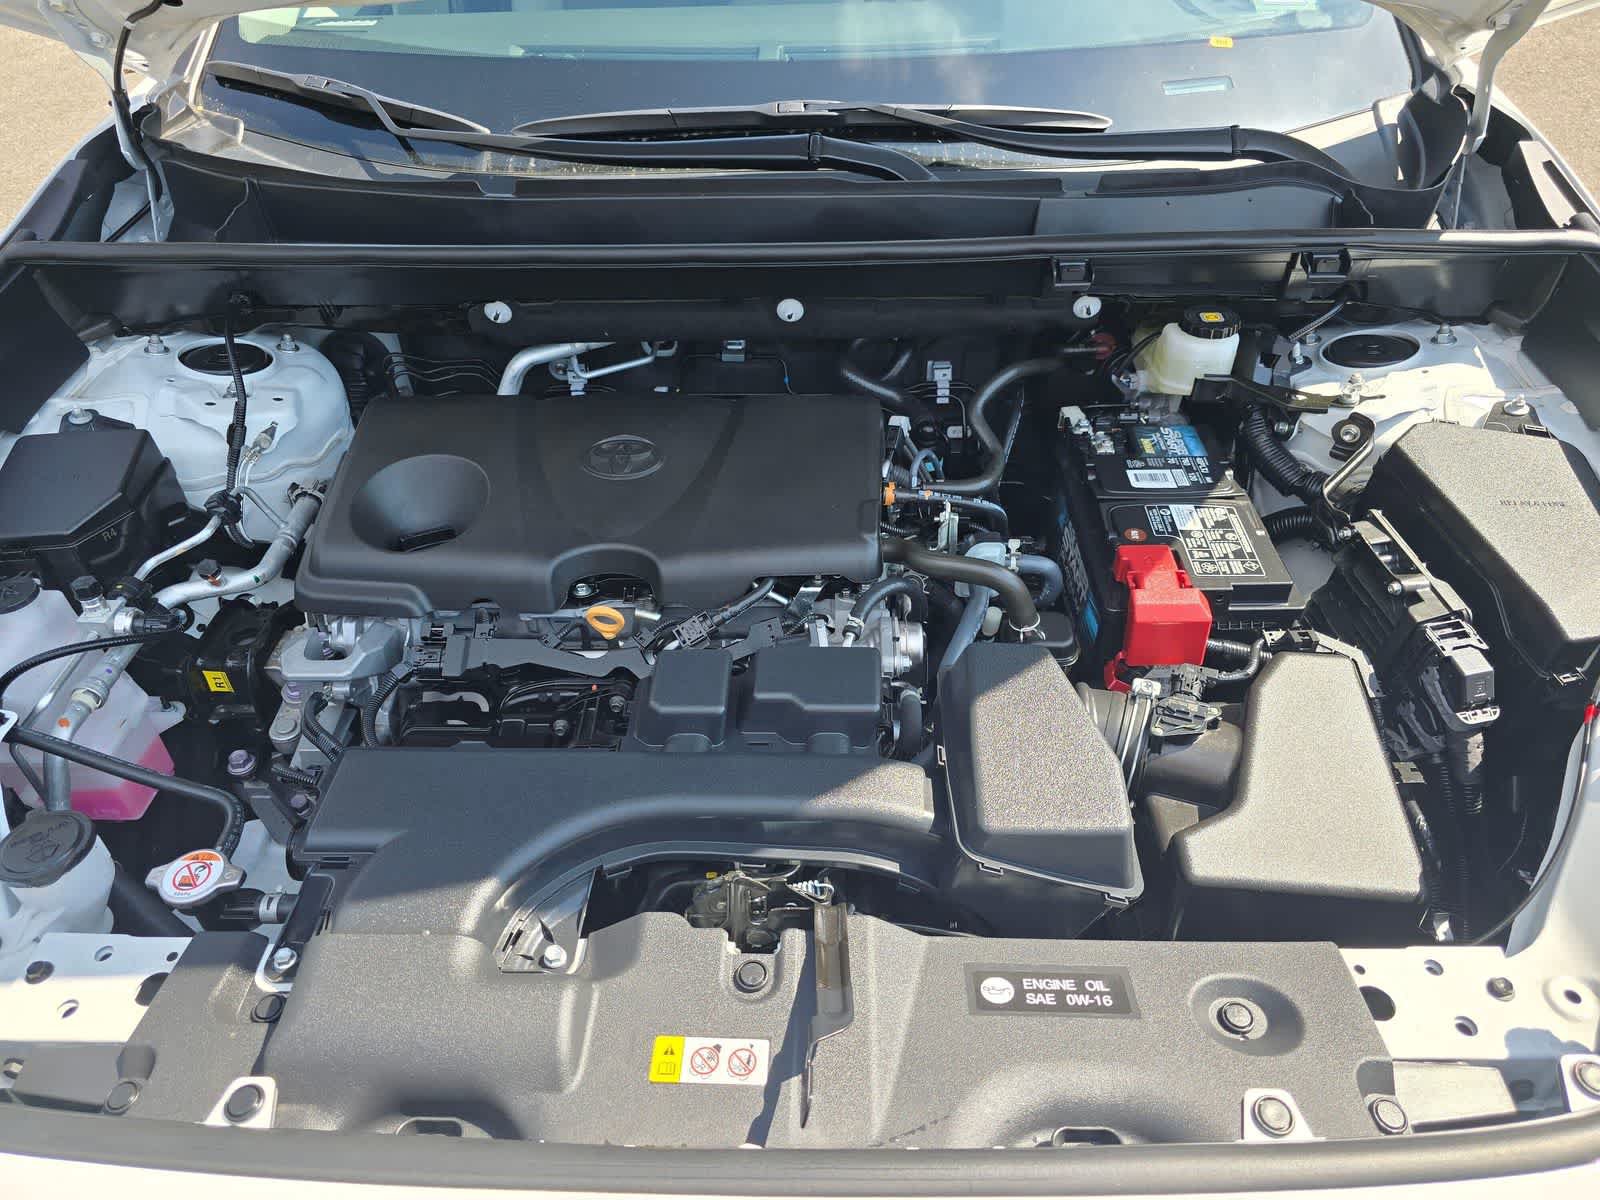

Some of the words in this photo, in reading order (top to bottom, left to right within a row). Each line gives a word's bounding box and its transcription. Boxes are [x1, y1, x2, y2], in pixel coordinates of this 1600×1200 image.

[1022, 978, 1077, 991] ENGINE
[1084, 980, 1110, 992] OIL
[1025, 993, 1057, 1005] SAE
[1066, 994, 1113, 1007] 0W-16
